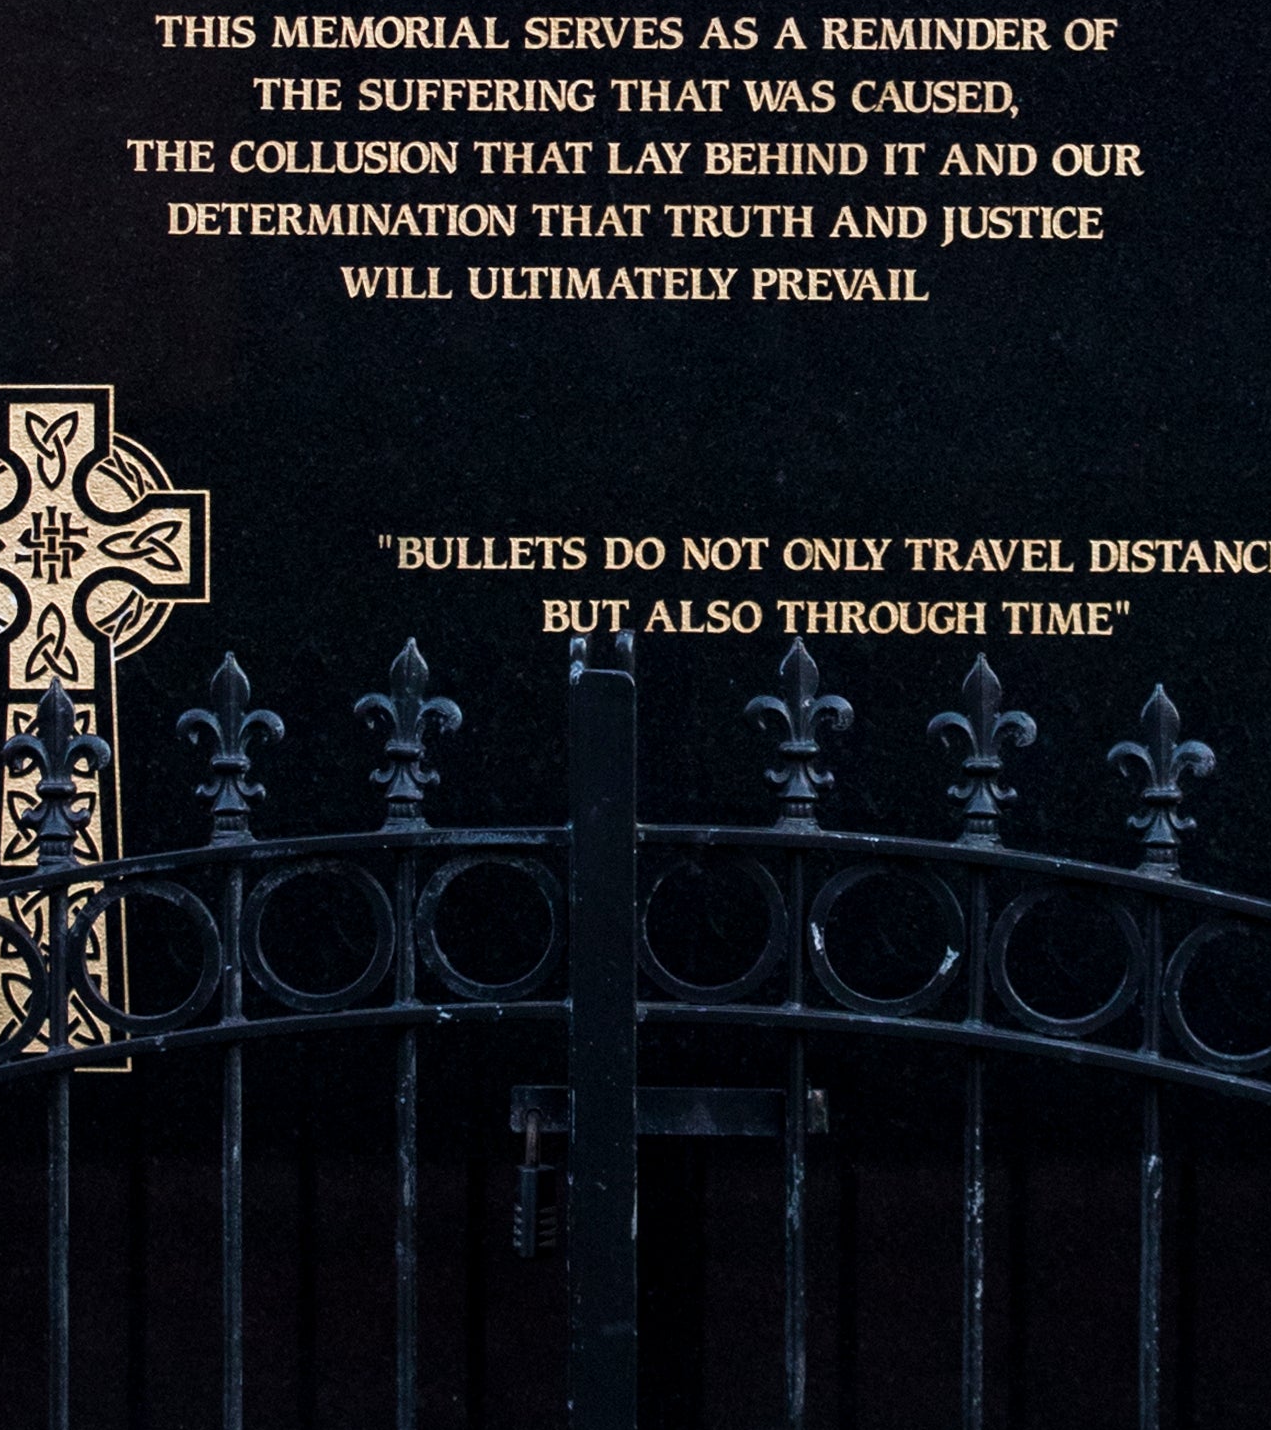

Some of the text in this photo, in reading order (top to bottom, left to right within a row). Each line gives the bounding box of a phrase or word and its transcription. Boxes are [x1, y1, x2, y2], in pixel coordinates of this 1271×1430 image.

[156, 15, 1118, 51] THIS MEMORIAL SERVES AS A REMINDER OF
[254, 78, 1018, 118] THE SUFFERING THAT WAS CAUSED,
[127, 139, 1144, 176] THE COLLUSION THAT LAY BEHIND IT AND OUR
[168, 203, 1103, 247] DETERMINATION THAT TRUTH AND JUSTICE
[341, 267, 929, 301] WILL ULTIMATELY PREVAIL
[379, 535, 587, 569] "BULLETS
[604, 537, 665, 570] DO
[683, 537, 769, 570] NOT
[783, 538, 892, 570] ONLY
[905, 538, 1074, 572] TRAVEL
[543, 600, 1129, 635] BUT ALSO THROUGH TIME"
